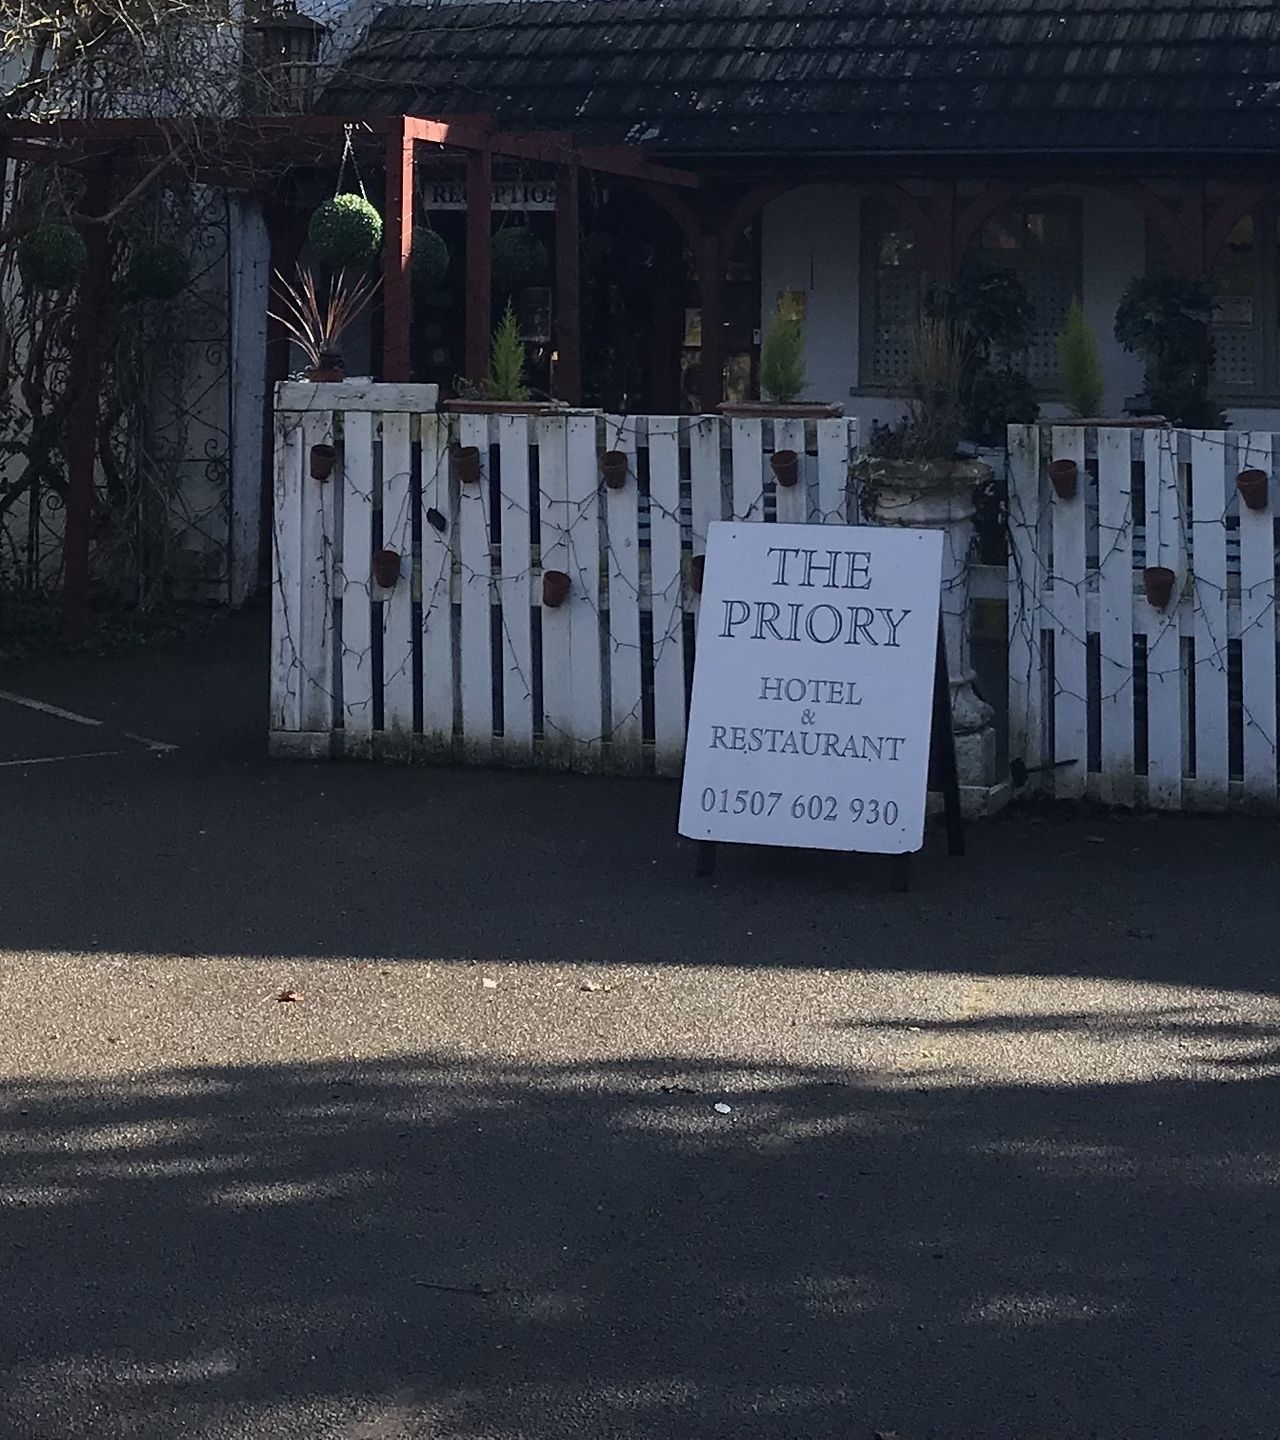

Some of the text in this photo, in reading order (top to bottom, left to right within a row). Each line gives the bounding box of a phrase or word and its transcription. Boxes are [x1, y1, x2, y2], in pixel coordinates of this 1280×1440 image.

[433, 185, 558, 203] REPTIO
[767, 547, 872, 590] THE
[718, 600, 912, 648] PRIORY
[758, 677, 863, 706] HOTEL
[800, 708, 816, 725] &
[708, 725, 906, 761] RESTAURANT
[701, 786, 899, 826] 01507 602 930
